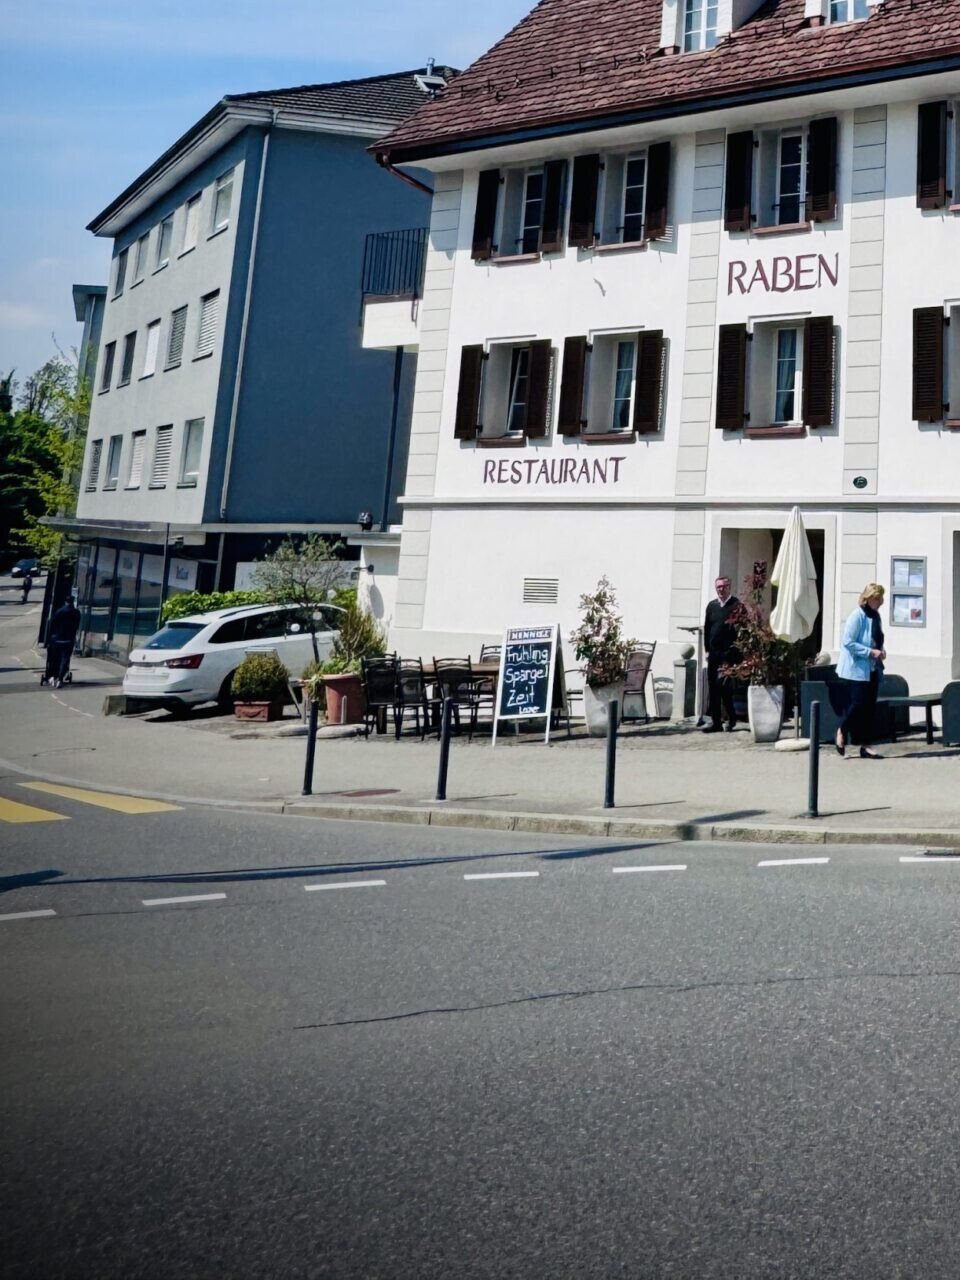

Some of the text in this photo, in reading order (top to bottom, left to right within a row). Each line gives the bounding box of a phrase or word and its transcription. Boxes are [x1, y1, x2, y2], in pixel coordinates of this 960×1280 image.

[727, 252, 839, 296] RABEN
[483, 456, 627, 484] RESTAURANT
[504, 664, 549, 688] Spargel
[507, 684, 535, 707] Zeit
